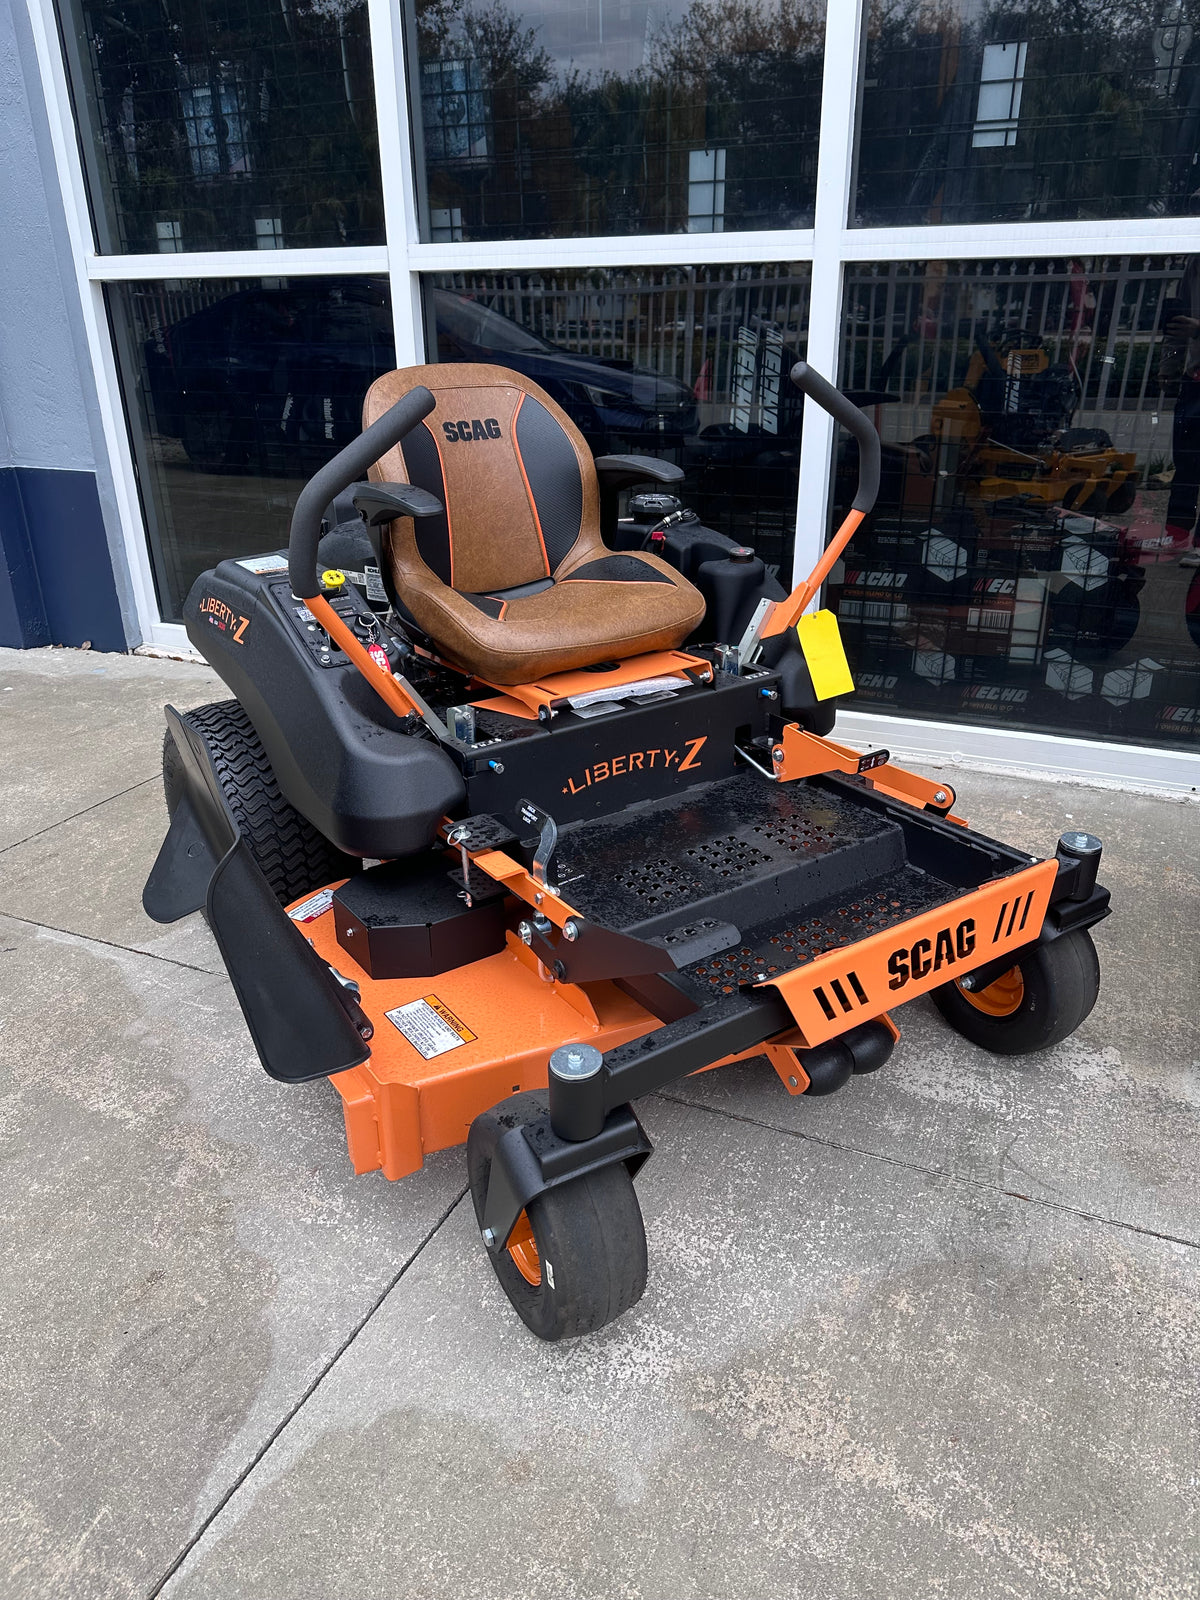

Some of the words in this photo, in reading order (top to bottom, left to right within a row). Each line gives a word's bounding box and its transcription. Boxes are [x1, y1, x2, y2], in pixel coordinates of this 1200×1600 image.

[442, 418, 502, 443] SCAG
[856, 571, 908, 588] ECHO
[201, 598, 237, 631] LIBERTY
[233, 615, 250, 645] Z
[856, 672, 899, 689] CHO
[976, 686, 1029, 703] ECHO
[568, 749, 677, 795] LIBERTY
[678, 736, 708, 772] Z
[888, 918, 976, 991] SCAG
[439, 1008, 464, 1033] WARNING
